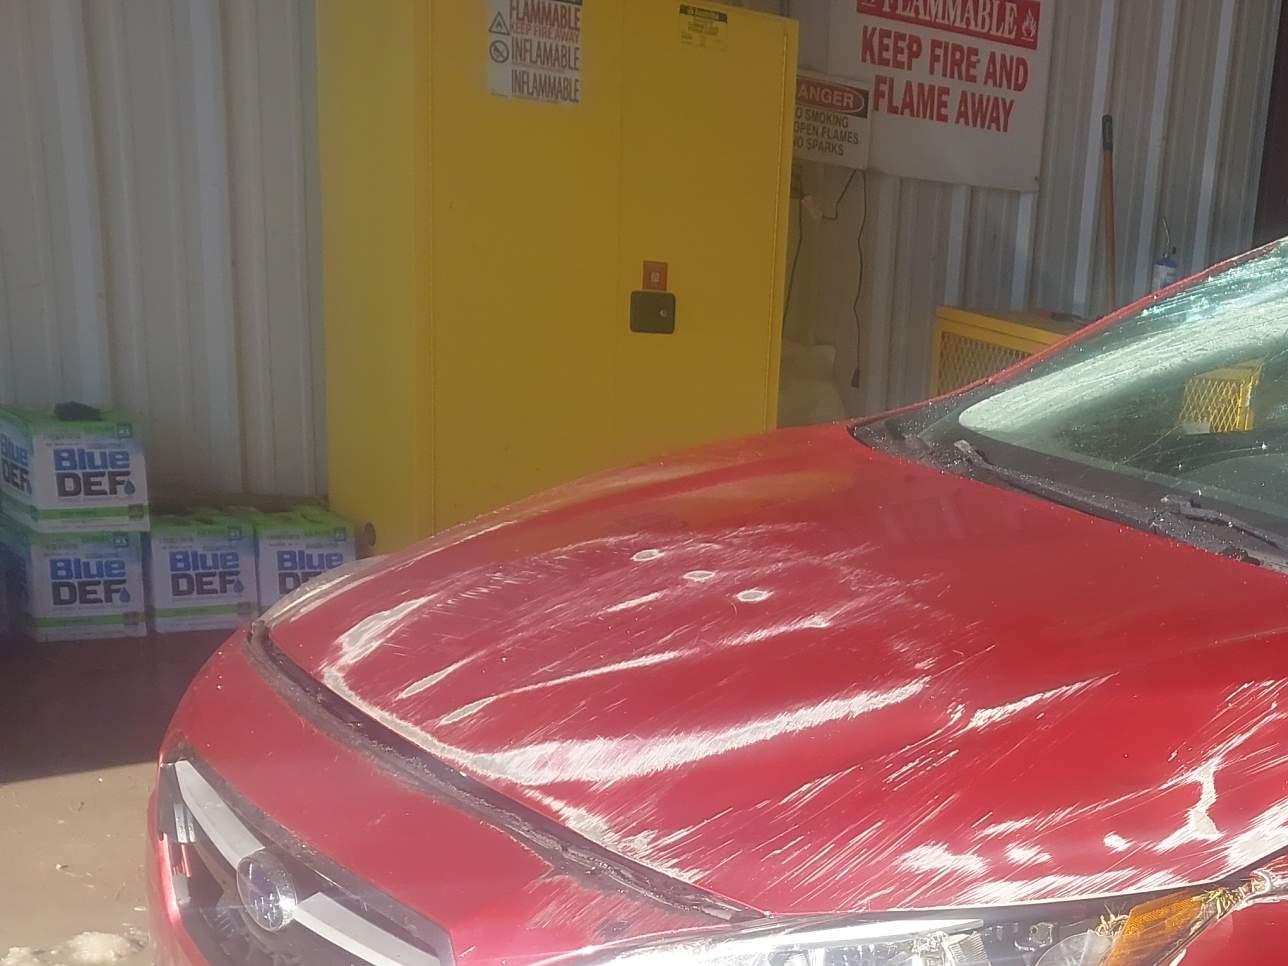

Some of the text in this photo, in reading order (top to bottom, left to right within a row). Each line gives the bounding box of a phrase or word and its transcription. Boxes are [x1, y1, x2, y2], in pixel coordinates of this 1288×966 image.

[510, 0, 580, 32] FLAMMABLE
[511, 36, 580, 71] INFLAMABLE
[861, 25, 1029, 92] KEEP FIRE AND
[511, 69, 580, 104] INFLAMMABLE
[797, 82, 854, 108] ANGER
[873, 74, 1014, 133] FLAME AWAY
[804, 108, 849, 129] SMOKING
[806, 137, 845, 156] SPARKS
[821, 126, 859, 145] FLAMES
[54, 448, 130, 471] Blue
[56, 470, 131, 497] DEF
[50, 557, 127, 580] Blue
[169, 550, 240, 572] Blue
[277, 550, 344, 571] Blue
[52, 579, 127, 606] DEF
[171, 571, 241, 597] DEF
